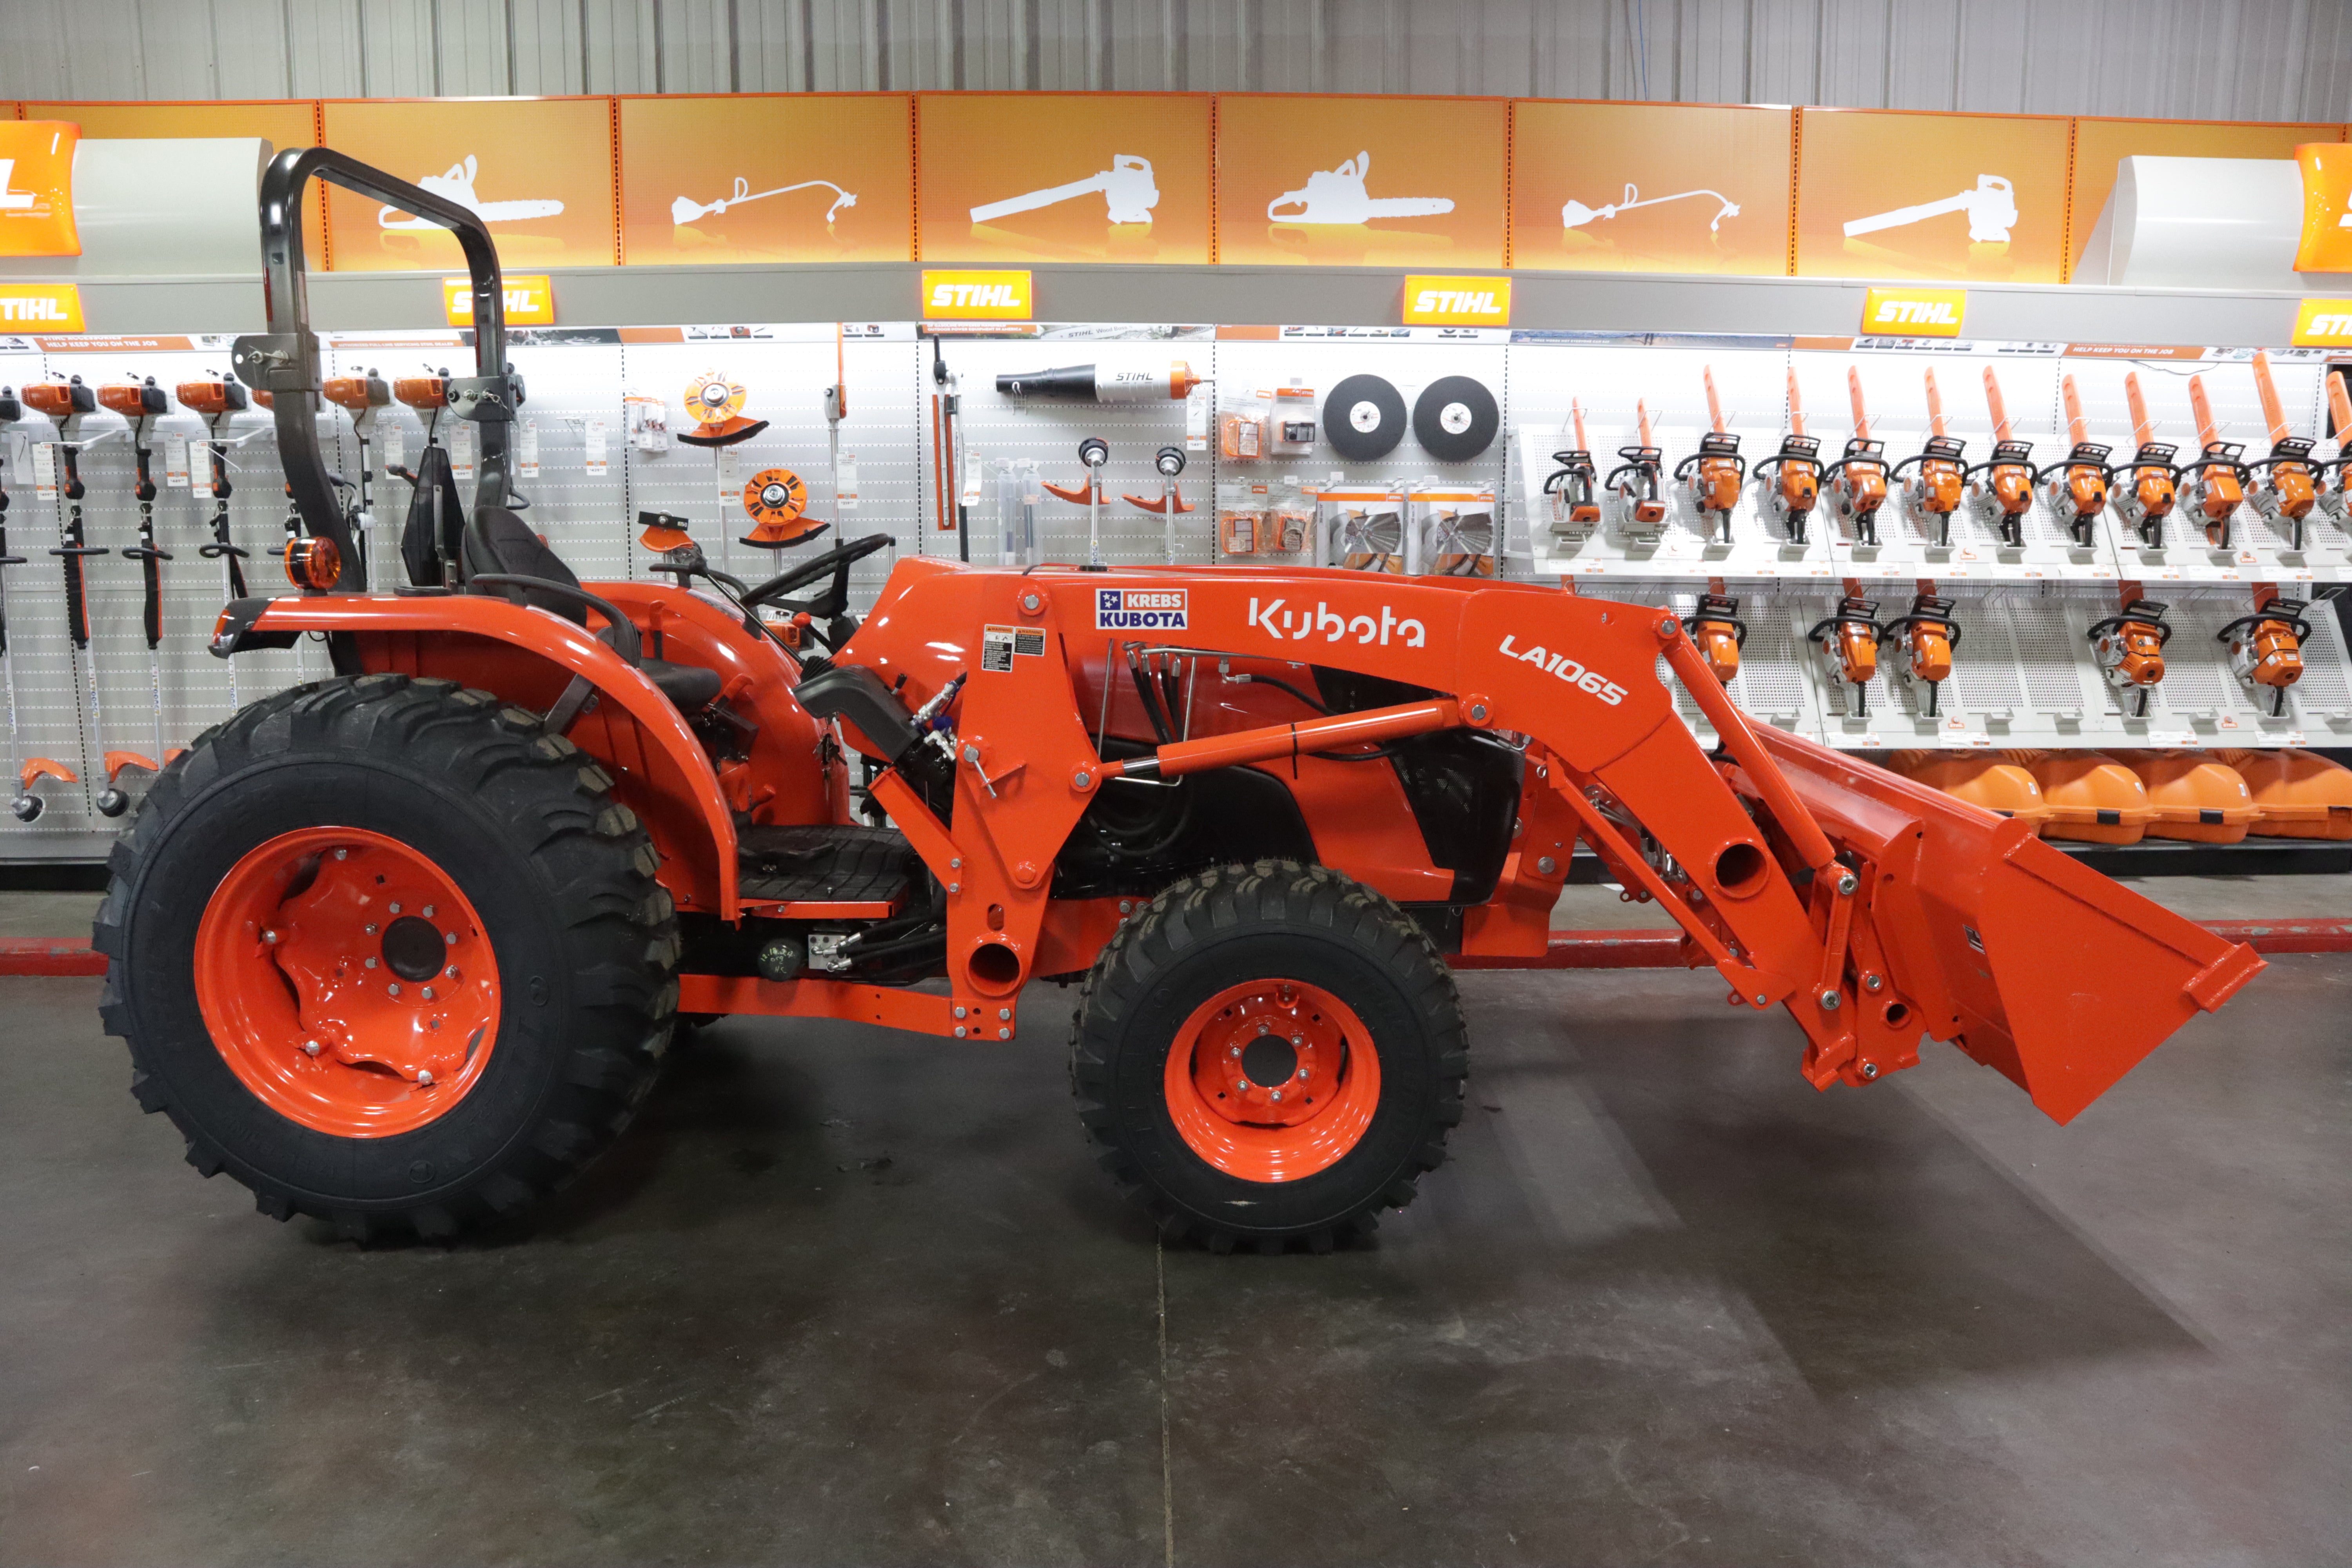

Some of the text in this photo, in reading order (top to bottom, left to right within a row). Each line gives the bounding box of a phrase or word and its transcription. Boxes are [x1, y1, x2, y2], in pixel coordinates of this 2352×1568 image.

[452, 290, 539, 312] SHL
[931, 285, 1020, 306] STIHL
[1414, 291, 1501, 313] STIHL
[0, 298, 67, 320] TIHL
[1875, 301, 1957, 323] STIHL
[2306, 314, 2352, 335] STI
[1116, 372, 1153, 381] STIHL
[1127, 594, 1181, 607] KREBS
[1100, 612, 1185, 627] KUBOTA
[1249, 597, 1425, 647] Kubota
[1499, 634, 1629, 705] LA1065
